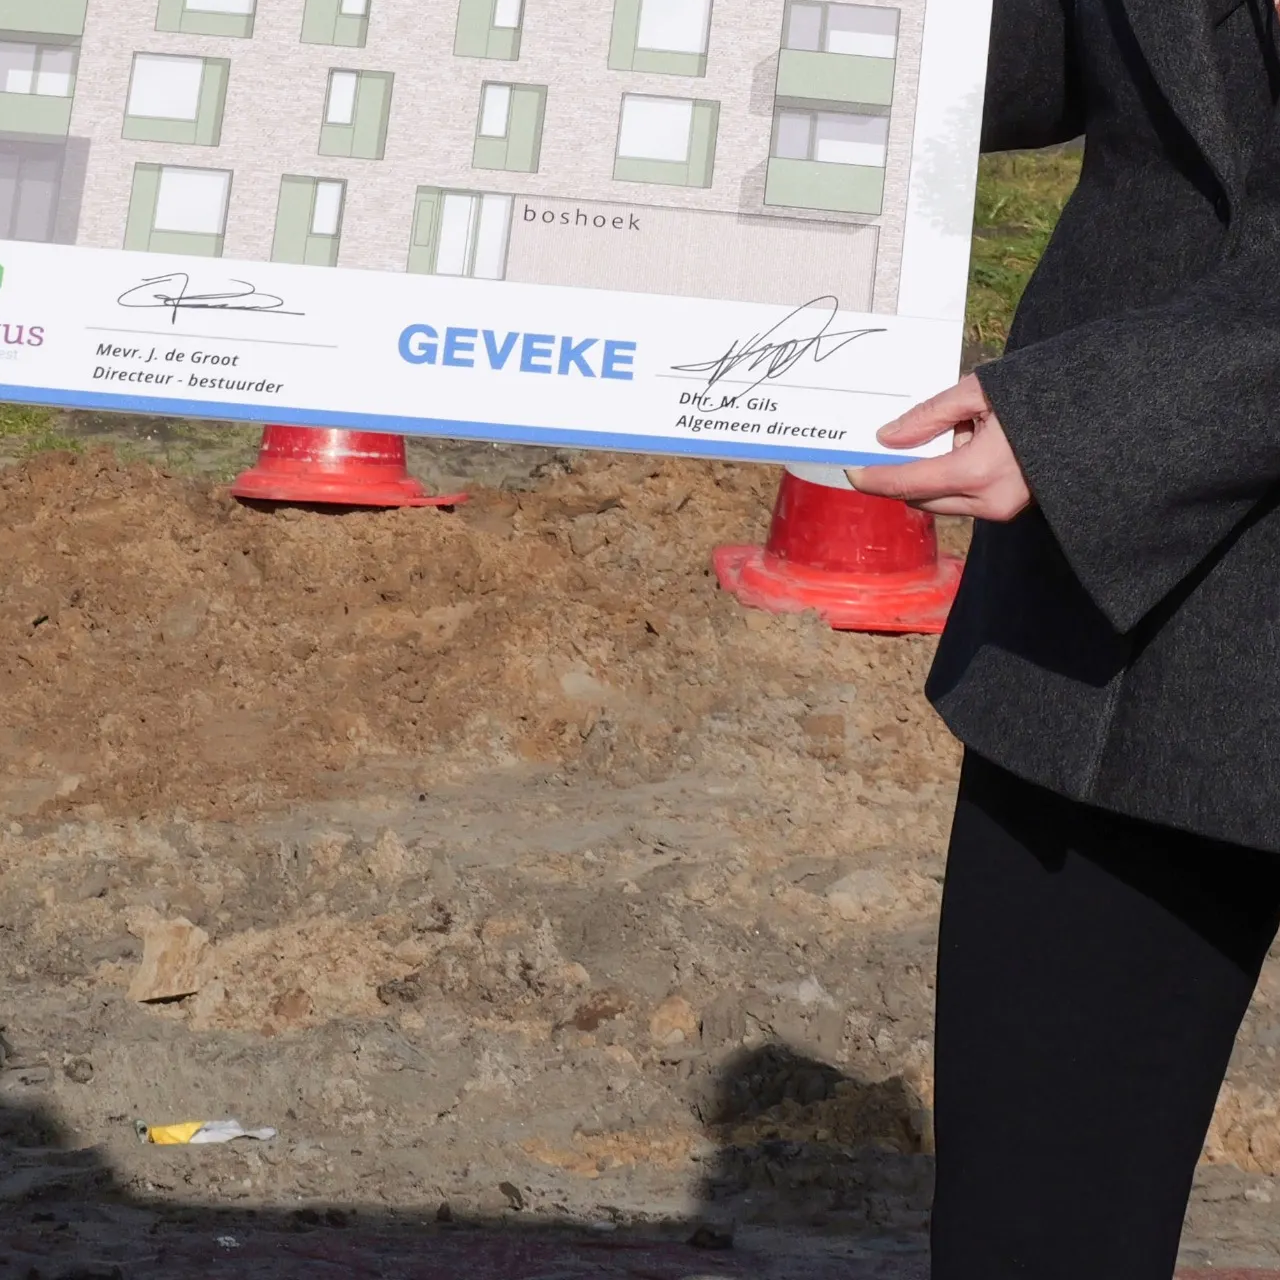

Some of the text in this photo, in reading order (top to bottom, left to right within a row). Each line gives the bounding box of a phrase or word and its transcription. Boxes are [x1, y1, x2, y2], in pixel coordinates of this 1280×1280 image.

[523, 204, 640, 231] boshoek
[95, 343, 240, 367] Mevr. J. de Groot
[397, 323, 637, 381] GEVEKE
[93, 366, 173, 385] Directeur
[188, 373, 284, 393] bestuurder
[678, 392, 778, 412] Dhr. M. Gils
[675, 415, 847, 440] Algemeen directeur
